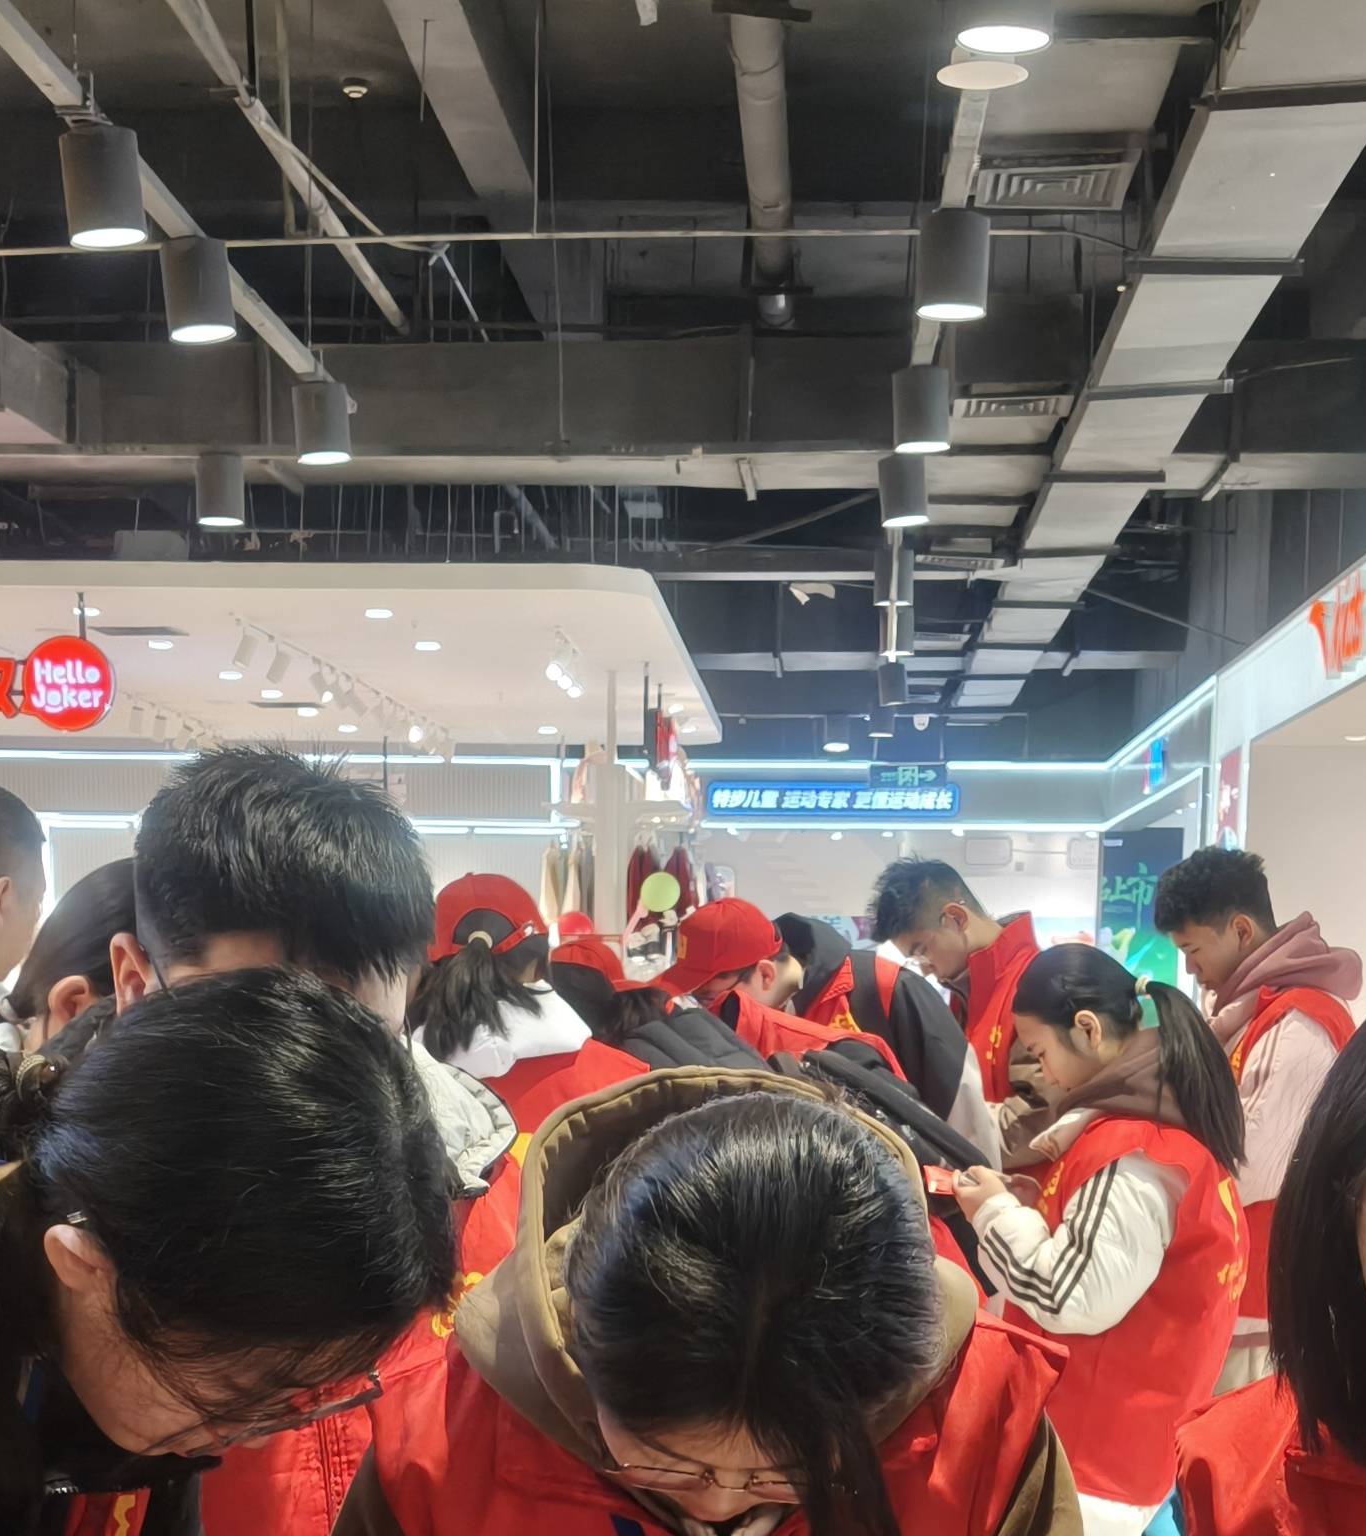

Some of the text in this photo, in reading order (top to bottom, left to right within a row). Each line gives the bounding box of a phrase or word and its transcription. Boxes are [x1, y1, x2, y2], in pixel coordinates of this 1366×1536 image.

[33, 657, 102, 685] Hello
[31, 684, 104, 711] Joker
[781, 789, 851, 810] 运动专家
